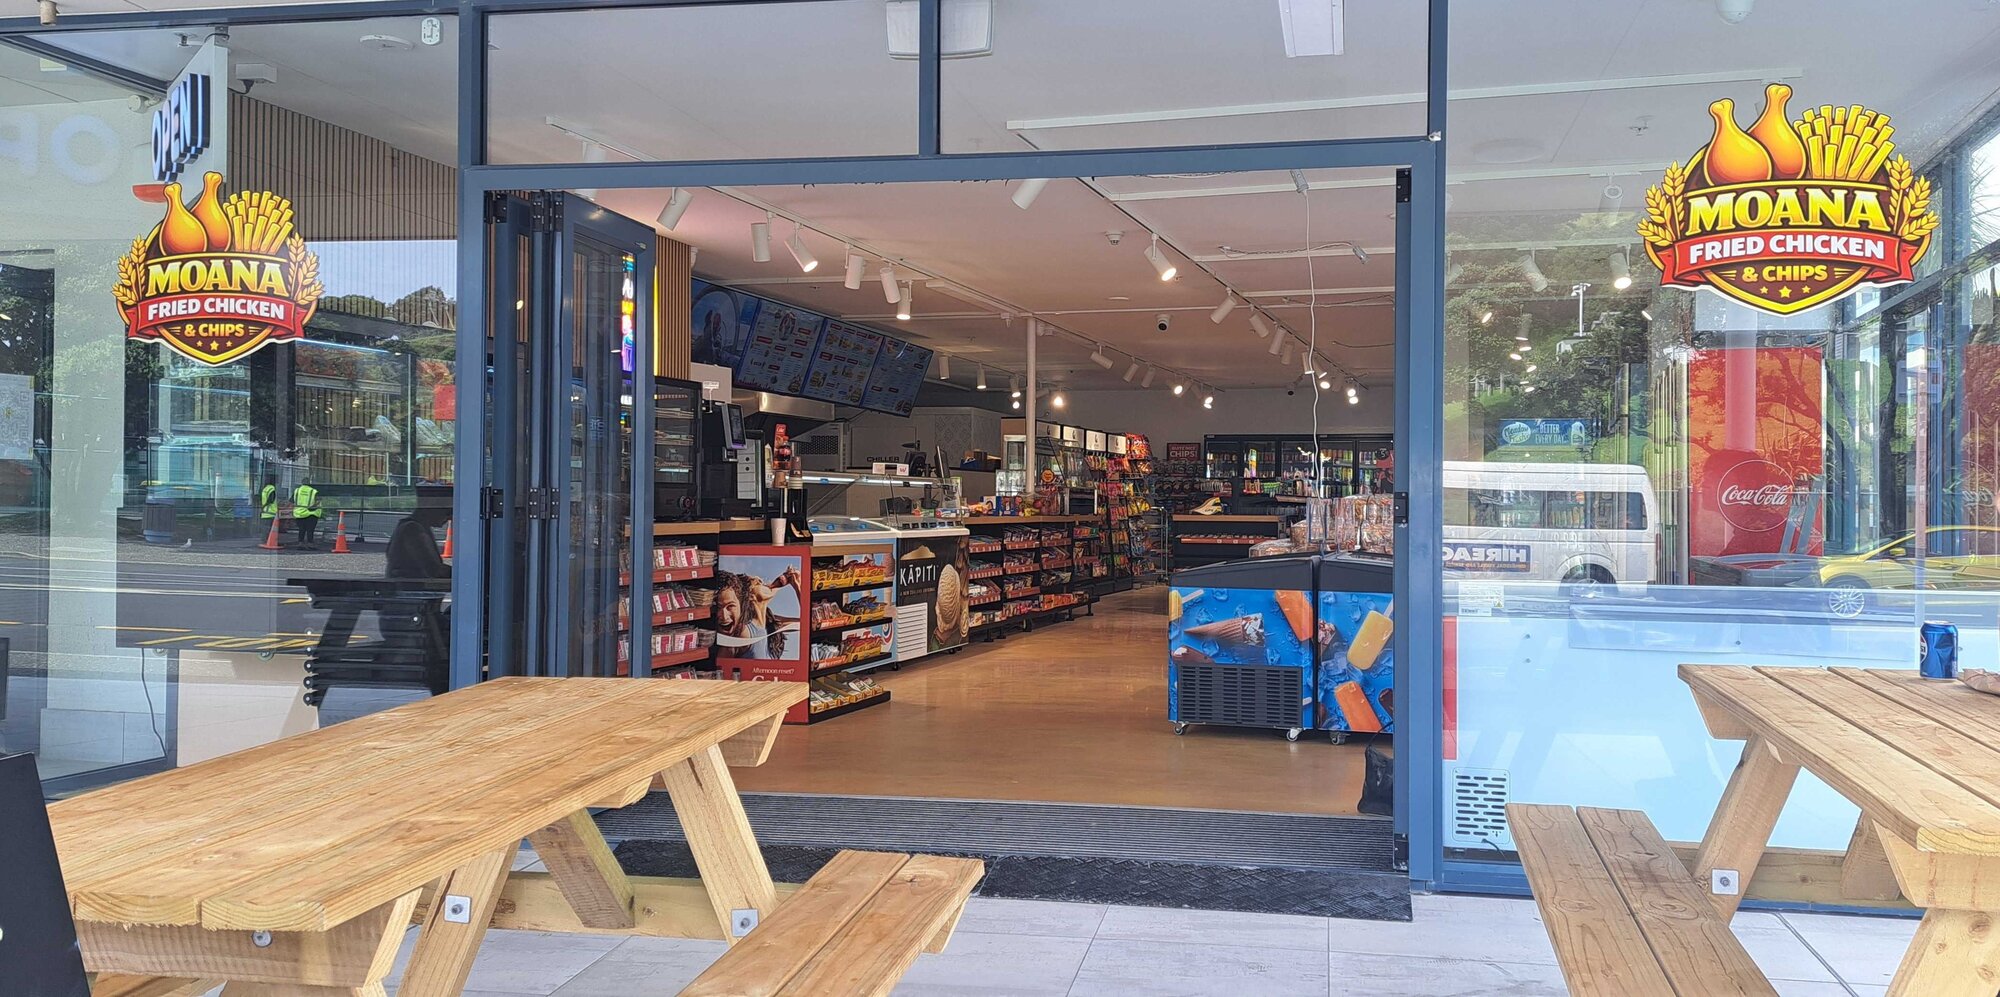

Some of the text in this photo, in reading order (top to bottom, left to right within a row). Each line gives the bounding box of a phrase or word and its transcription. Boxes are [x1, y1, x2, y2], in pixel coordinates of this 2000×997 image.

[151, 73, 193, 182] OPEN
[1686, 187, 1890, 235] MOANA
[1689, 234, 1886, 264] FRIED CHICKEN
[146, 260, 290, 297] MOANA
[1742, 264, 1828, 283] & CHIPS
[147, 297, 285, 321] FRIED CHICKEN
[184, 323, 245, 338] & CHIPS
[1535, 434, 1552, 444] EVERY
[1540, 423, 1560, 433] BETTER
[1721, 484, 1791, 506] Coca-Cola
[899, 564, 937, 587] KĀPITI
